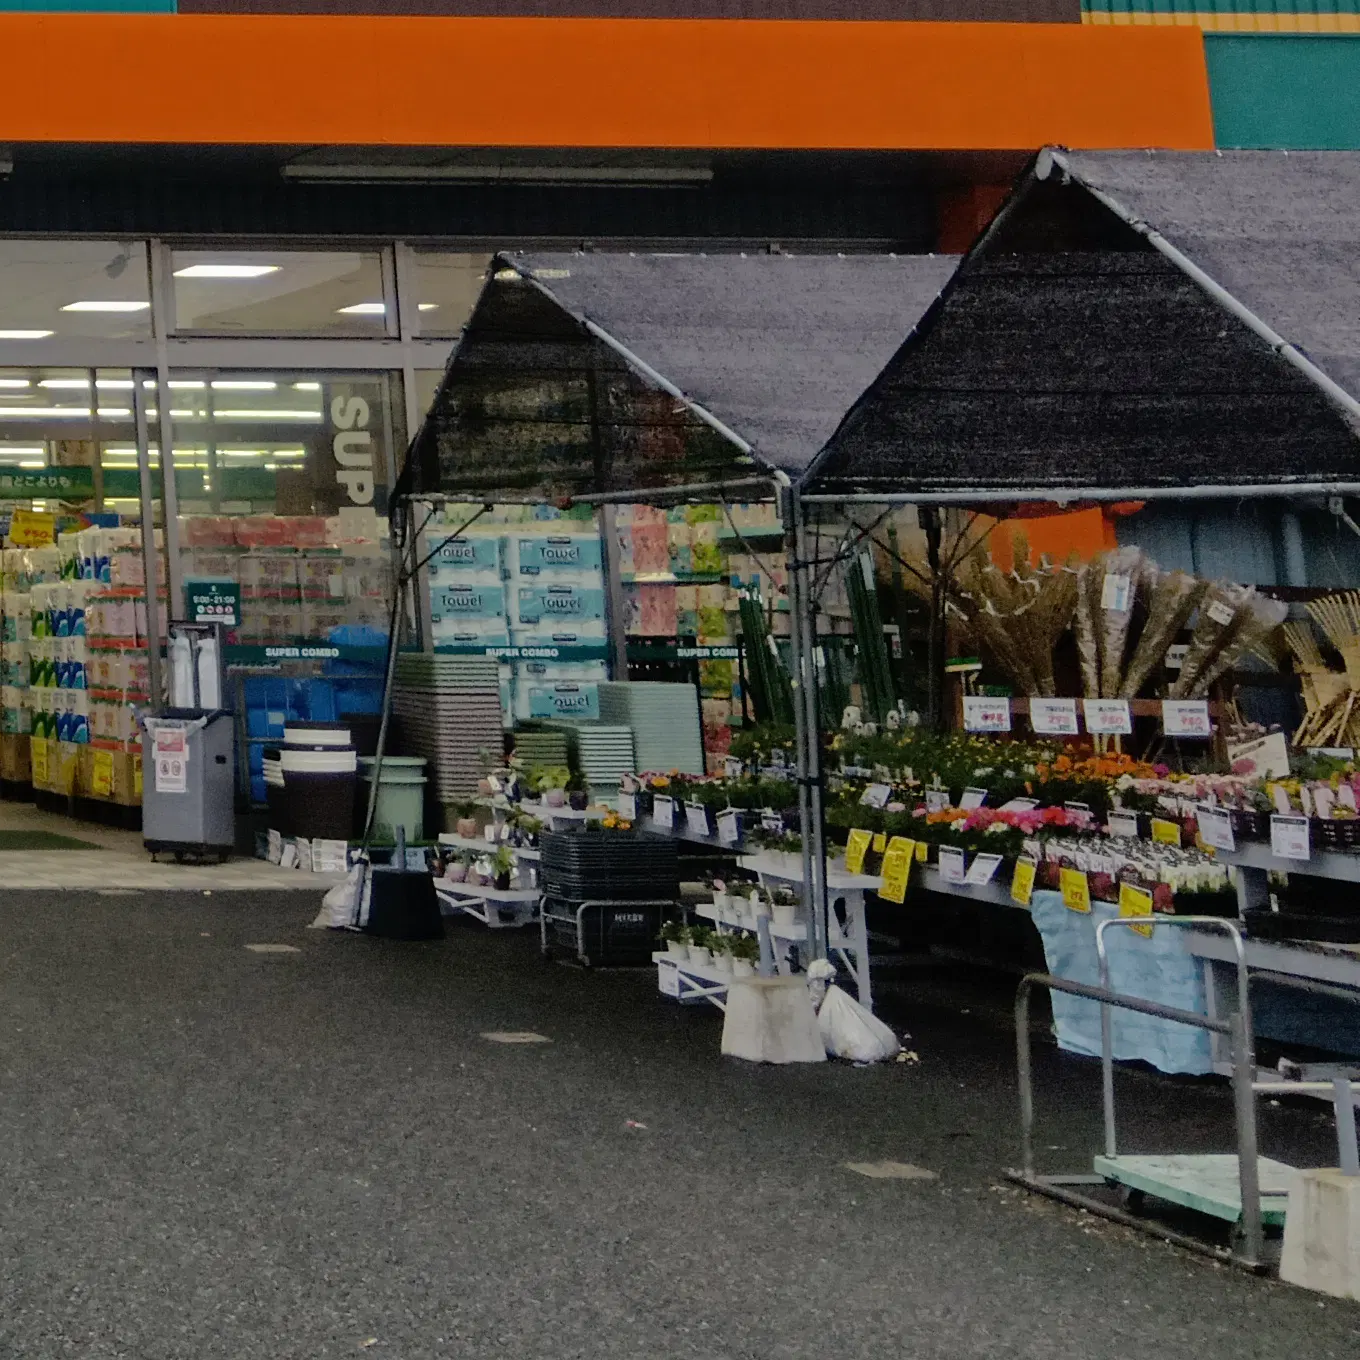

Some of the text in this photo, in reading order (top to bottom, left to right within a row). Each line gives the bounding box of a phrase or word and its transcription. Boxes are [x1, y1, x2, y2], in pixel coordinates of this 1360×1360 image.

[540, 546, 580, 559] Towel
[442, 594, 482, 607] Towel
[541, 595, 581, 609] Towel
[265, 647, 340, 658] SUPER COMBO
[485, 648, 559, 658] SUPER COMBO
[677, 648, 710, 657] SUPER
[549, 693, 590, 707] owel
